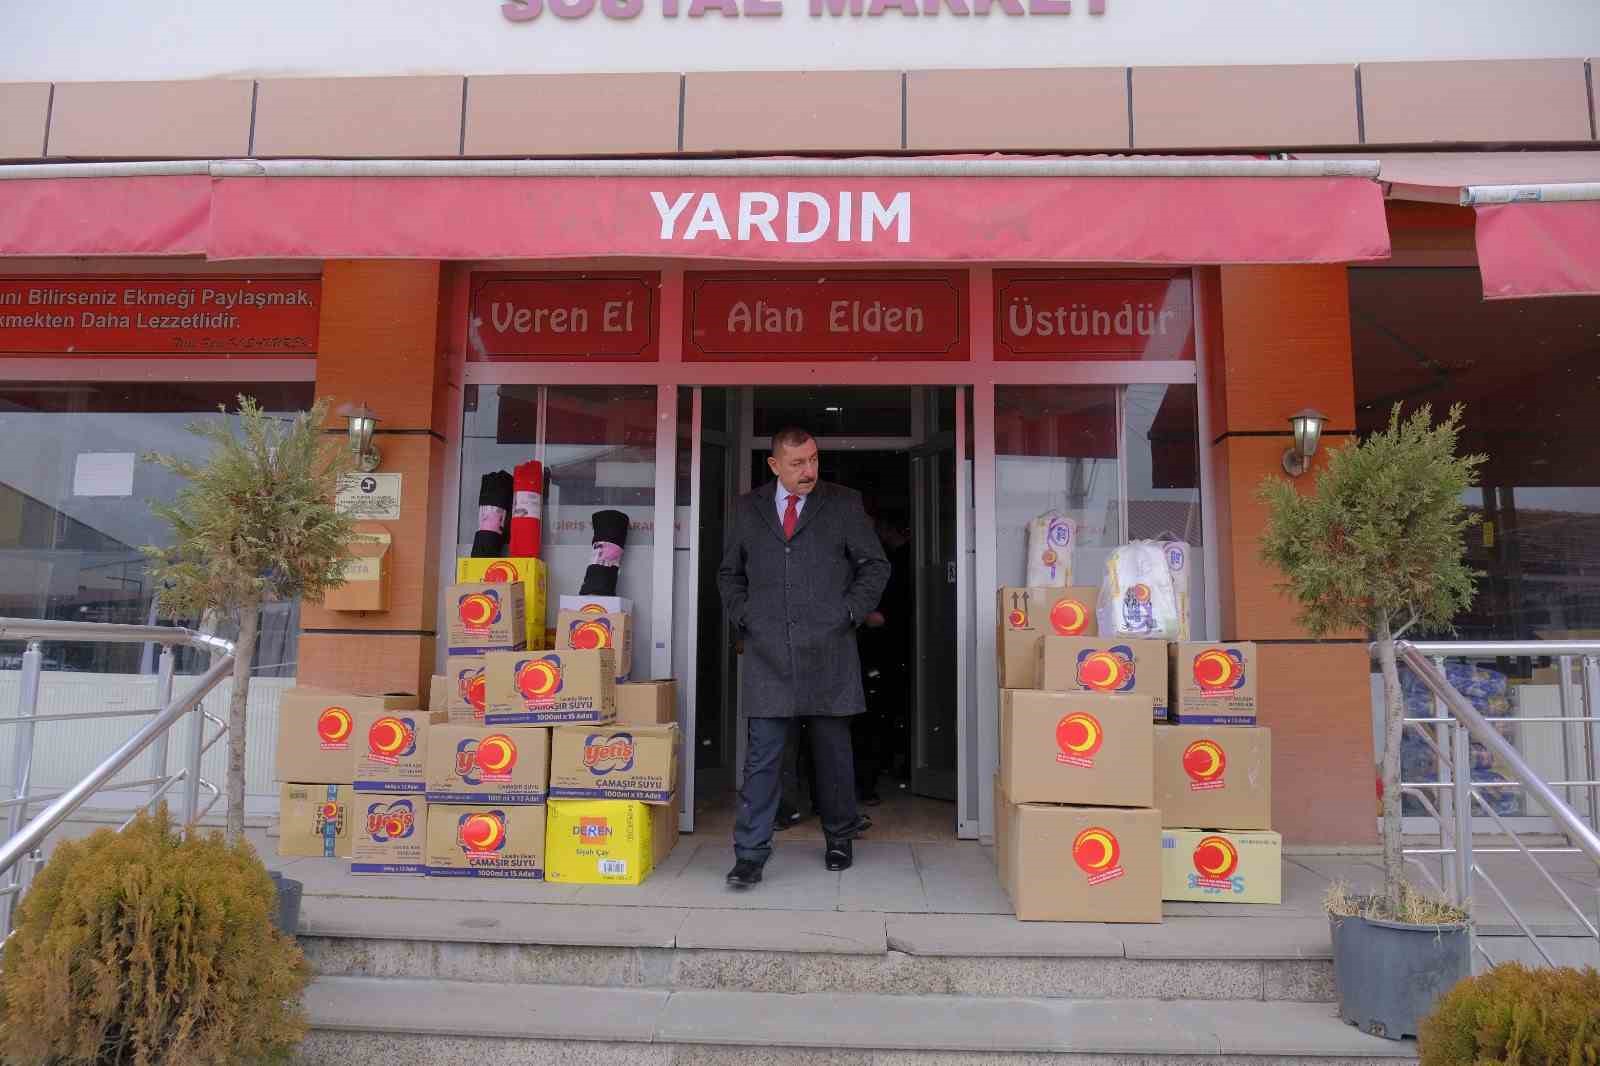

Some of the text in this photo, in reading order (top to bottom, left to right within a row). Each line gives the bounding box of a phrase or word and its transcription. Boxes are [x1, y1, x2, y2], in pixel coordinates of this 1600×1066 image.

[650, 191, 911, 242] YARDIM
[28, 288, 117, 305] Bilirseniz
[123, 287, 195, 309] Ekmeği
[202, 288, 313, 309] Paylaşmak,
[81, 312, 130, 328] Daha
[137, 312, 240, 328] Lezzetlidir.
[491, 301, 633, 333] Veren El
[727, 300, 924, 333] Alan Elden
[1009, 297, 1175, 336] Üstündür
[573, 824, 613, 837] DEREN
